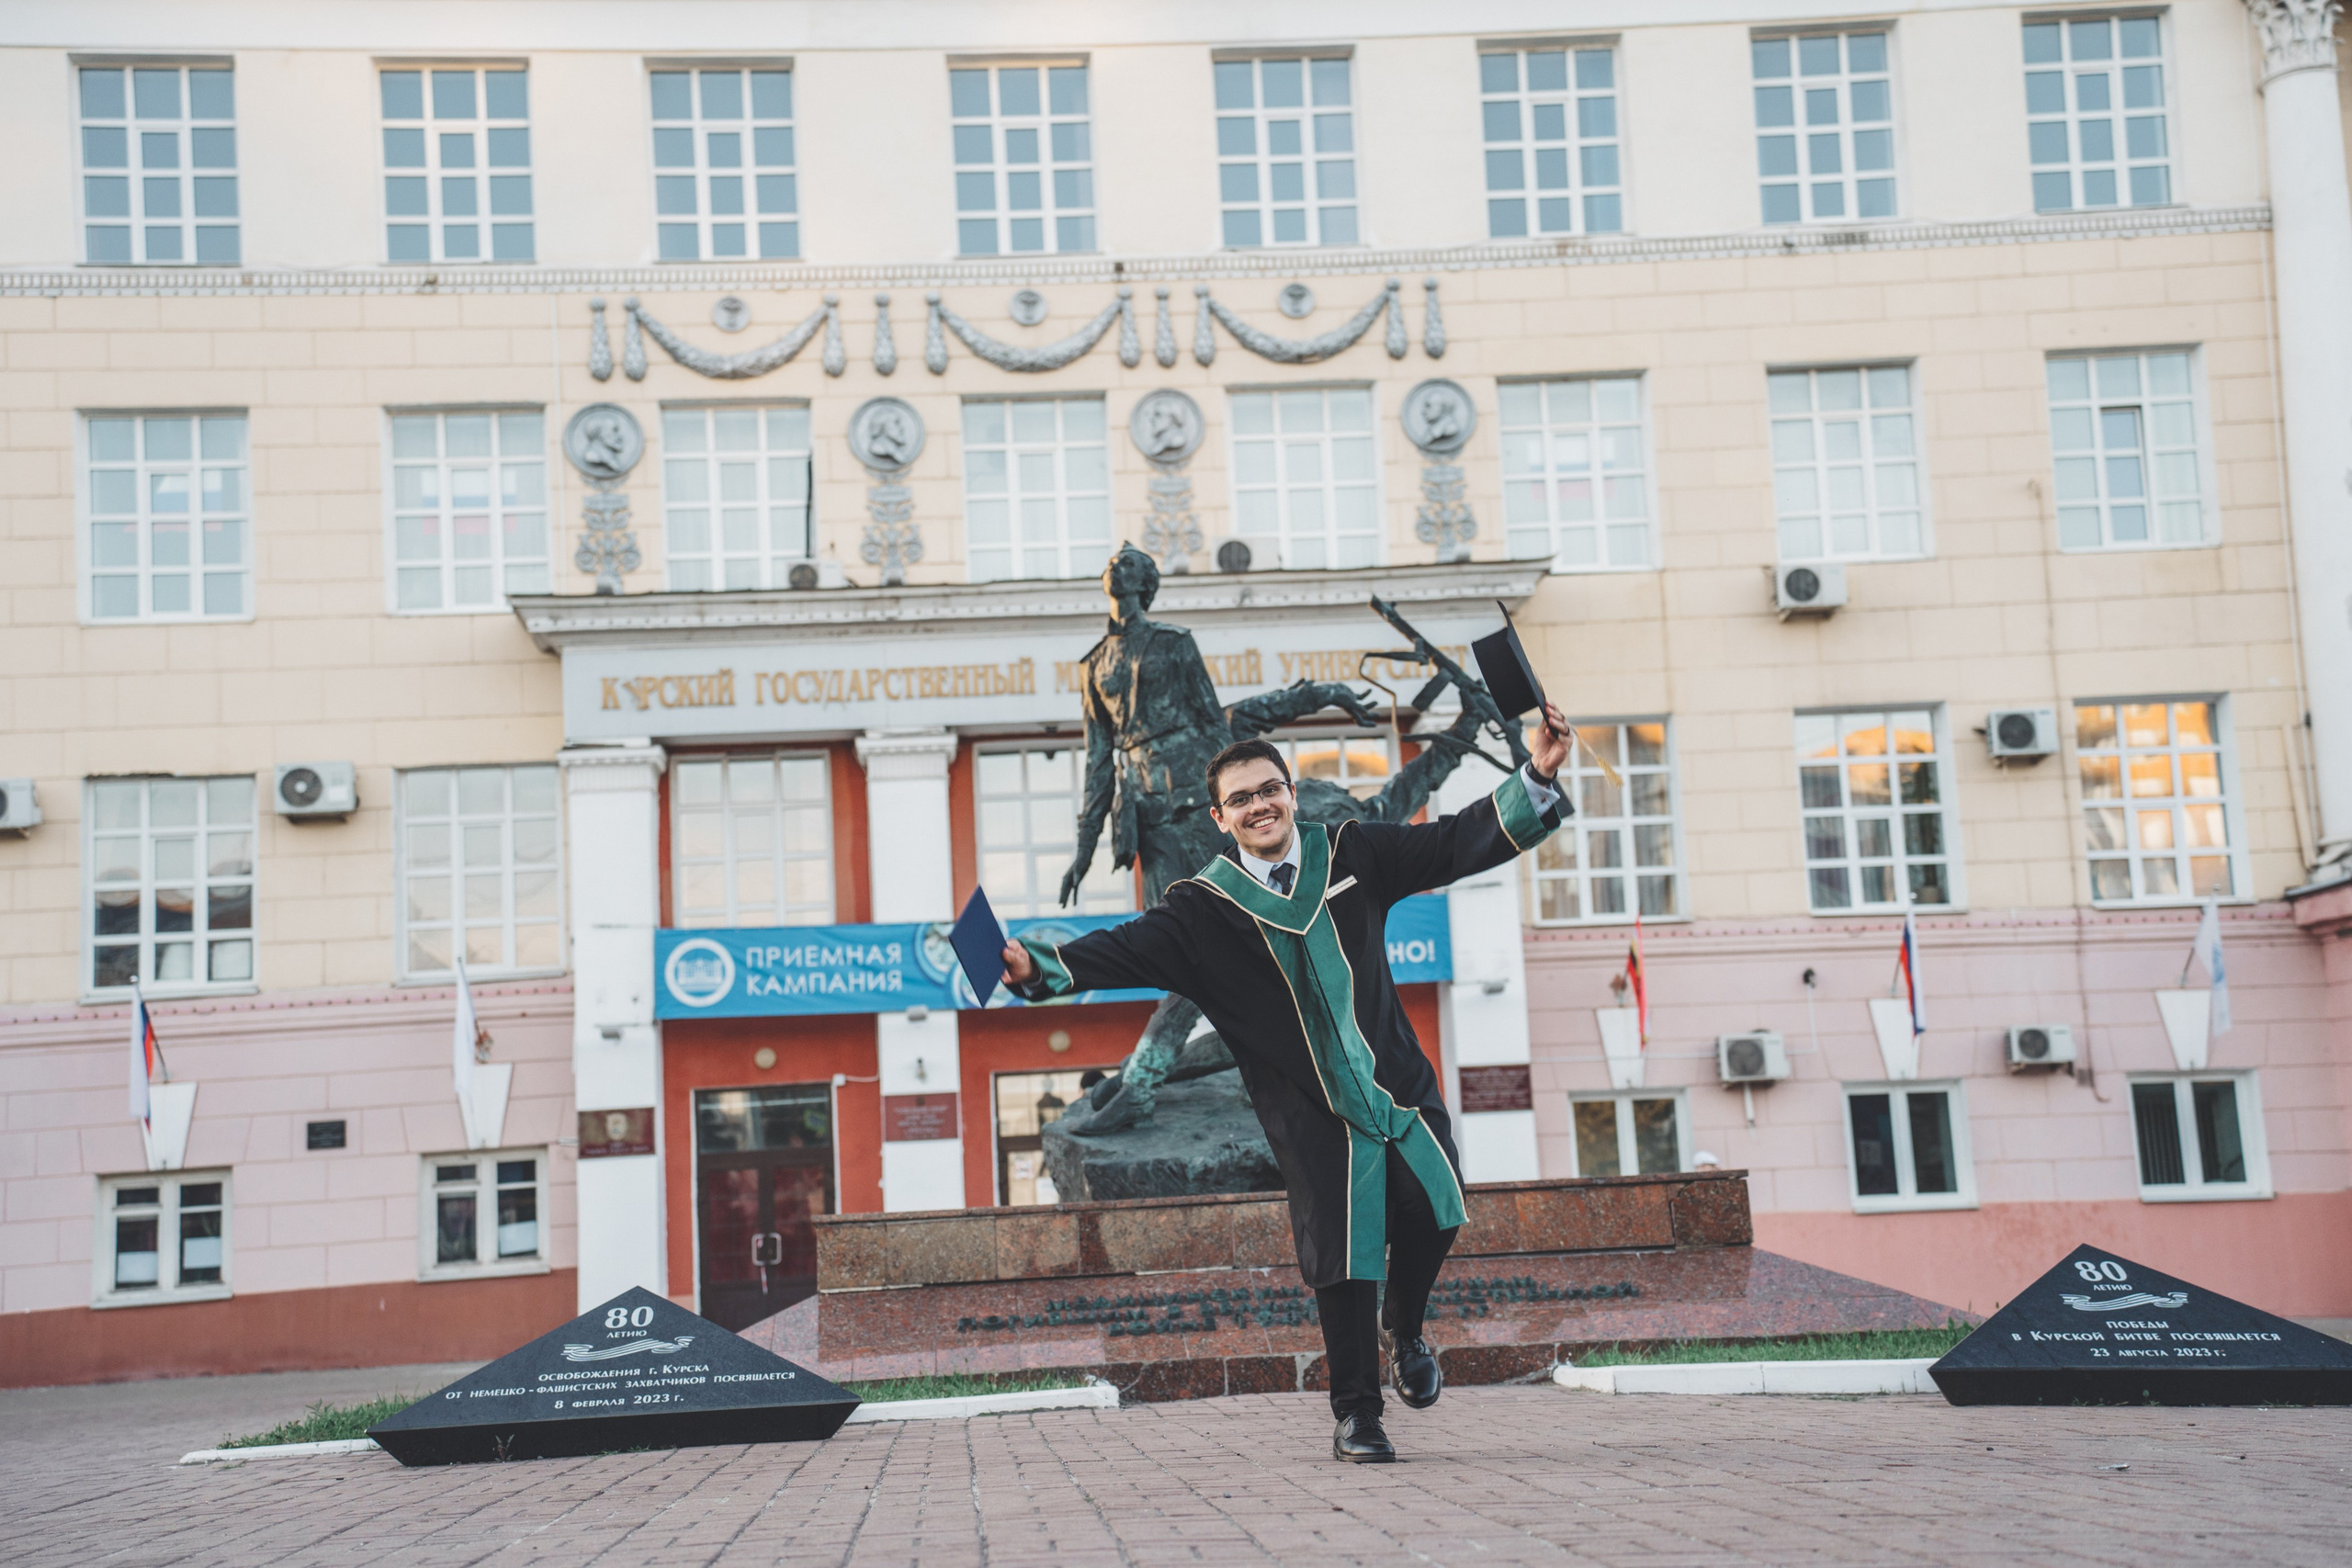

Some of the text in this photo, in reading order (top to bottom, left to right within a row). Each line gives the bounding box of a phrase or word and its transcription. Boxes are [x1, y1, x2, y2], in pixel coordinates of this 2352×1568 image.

[601, 668, 736, 711] КУРСКИЙ
[755, 657, 1036, 705] ГОСУДАРСТВЕННЫЙ
[1278, 645, 1468, 683] УНИВЕРСИТ
[746, 943, 902, 969] ПРИЕМНАЯ
[746, 969, 902, 997] КАМПАНИЯ
[2074, 1260, 2128, 1282] 80
[2093, 1283, 2132, 1292] ЛЕТИЮ
[1199, 1296, 1317, 1317] ВЕЛИКО
[604, 1306, 655, 1329] 80
[2105, 1320, 2170, 1330] ПОБЕДЫ
[605, 1329, 648, 1339] ЛЕТИЮ
[2114, 1332, 2162, 1341] БИТВЕ
[2169, 1332, 2282, 1342] ПОСВЯЩАЕТСЯ
[2089, 1348, 2110, 1358] 23
[2118, 1349, 2169, 1358] АВГУСТА
[2173, 1348, 2212, 1358] 2023
[537, 1368, 641, 1382] ОСВОБОЖДЕНИЯ
[445, 1391, 463, 1400] ОТ
[624, 1375, 707, 1389] ЗАХВАТЧИКОВ
[713, 1371, 797, 1383] ПОСВЯЩАЕТСЯ
[553, 1399, 565, 1410] 8
[571, 1397, 626, 1409] ФЕВРАЛЯ
[633, 1393, 671, 1404] 2023
